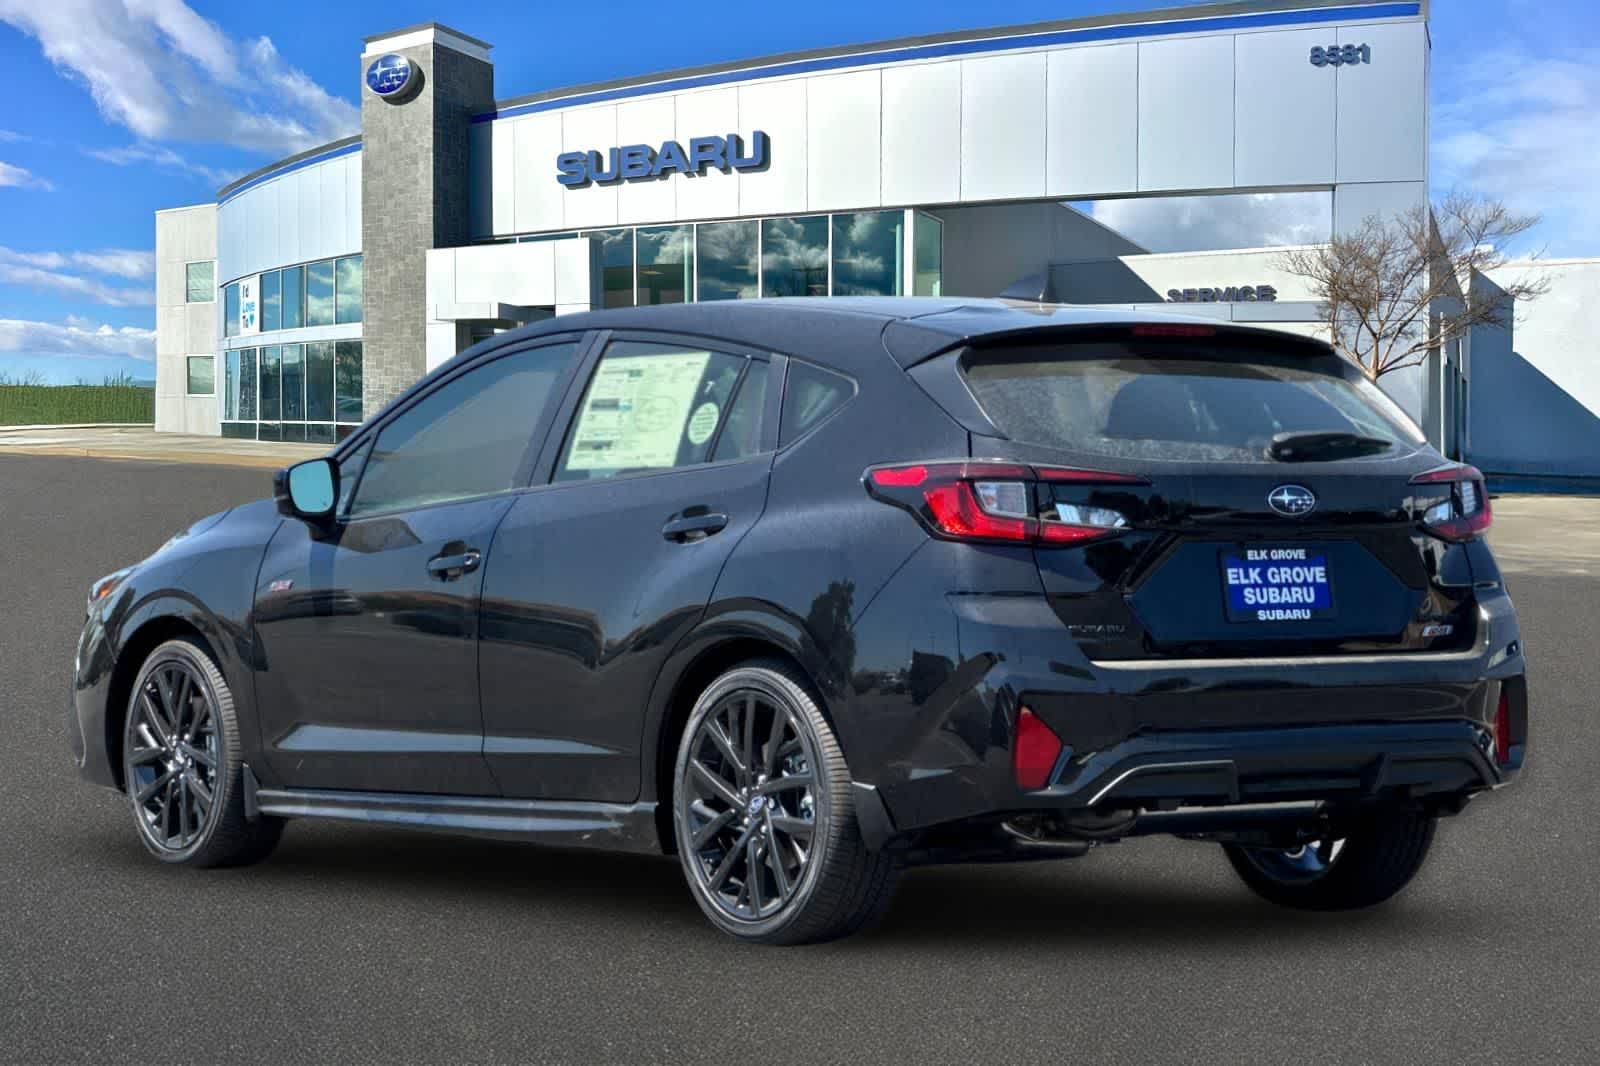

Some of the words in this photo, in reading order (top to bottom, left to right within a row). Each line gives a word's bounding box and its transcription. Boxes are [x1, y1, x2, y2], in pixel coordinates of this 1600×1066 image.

[556, 130, 771, 190] SUBARU
[1167, 285, 1277, 302] SERVICE
[1247, 550, 1268, 560] ELK
[1270, 549, 1306, 560] GROVE
[1227, 567, 1262, 584] ELK
[1267, 566, 1327, 583] GROVE
[1243, 587, 1315, 604] SUBARU
[1257, 609, 1311, 620] SUBARU
